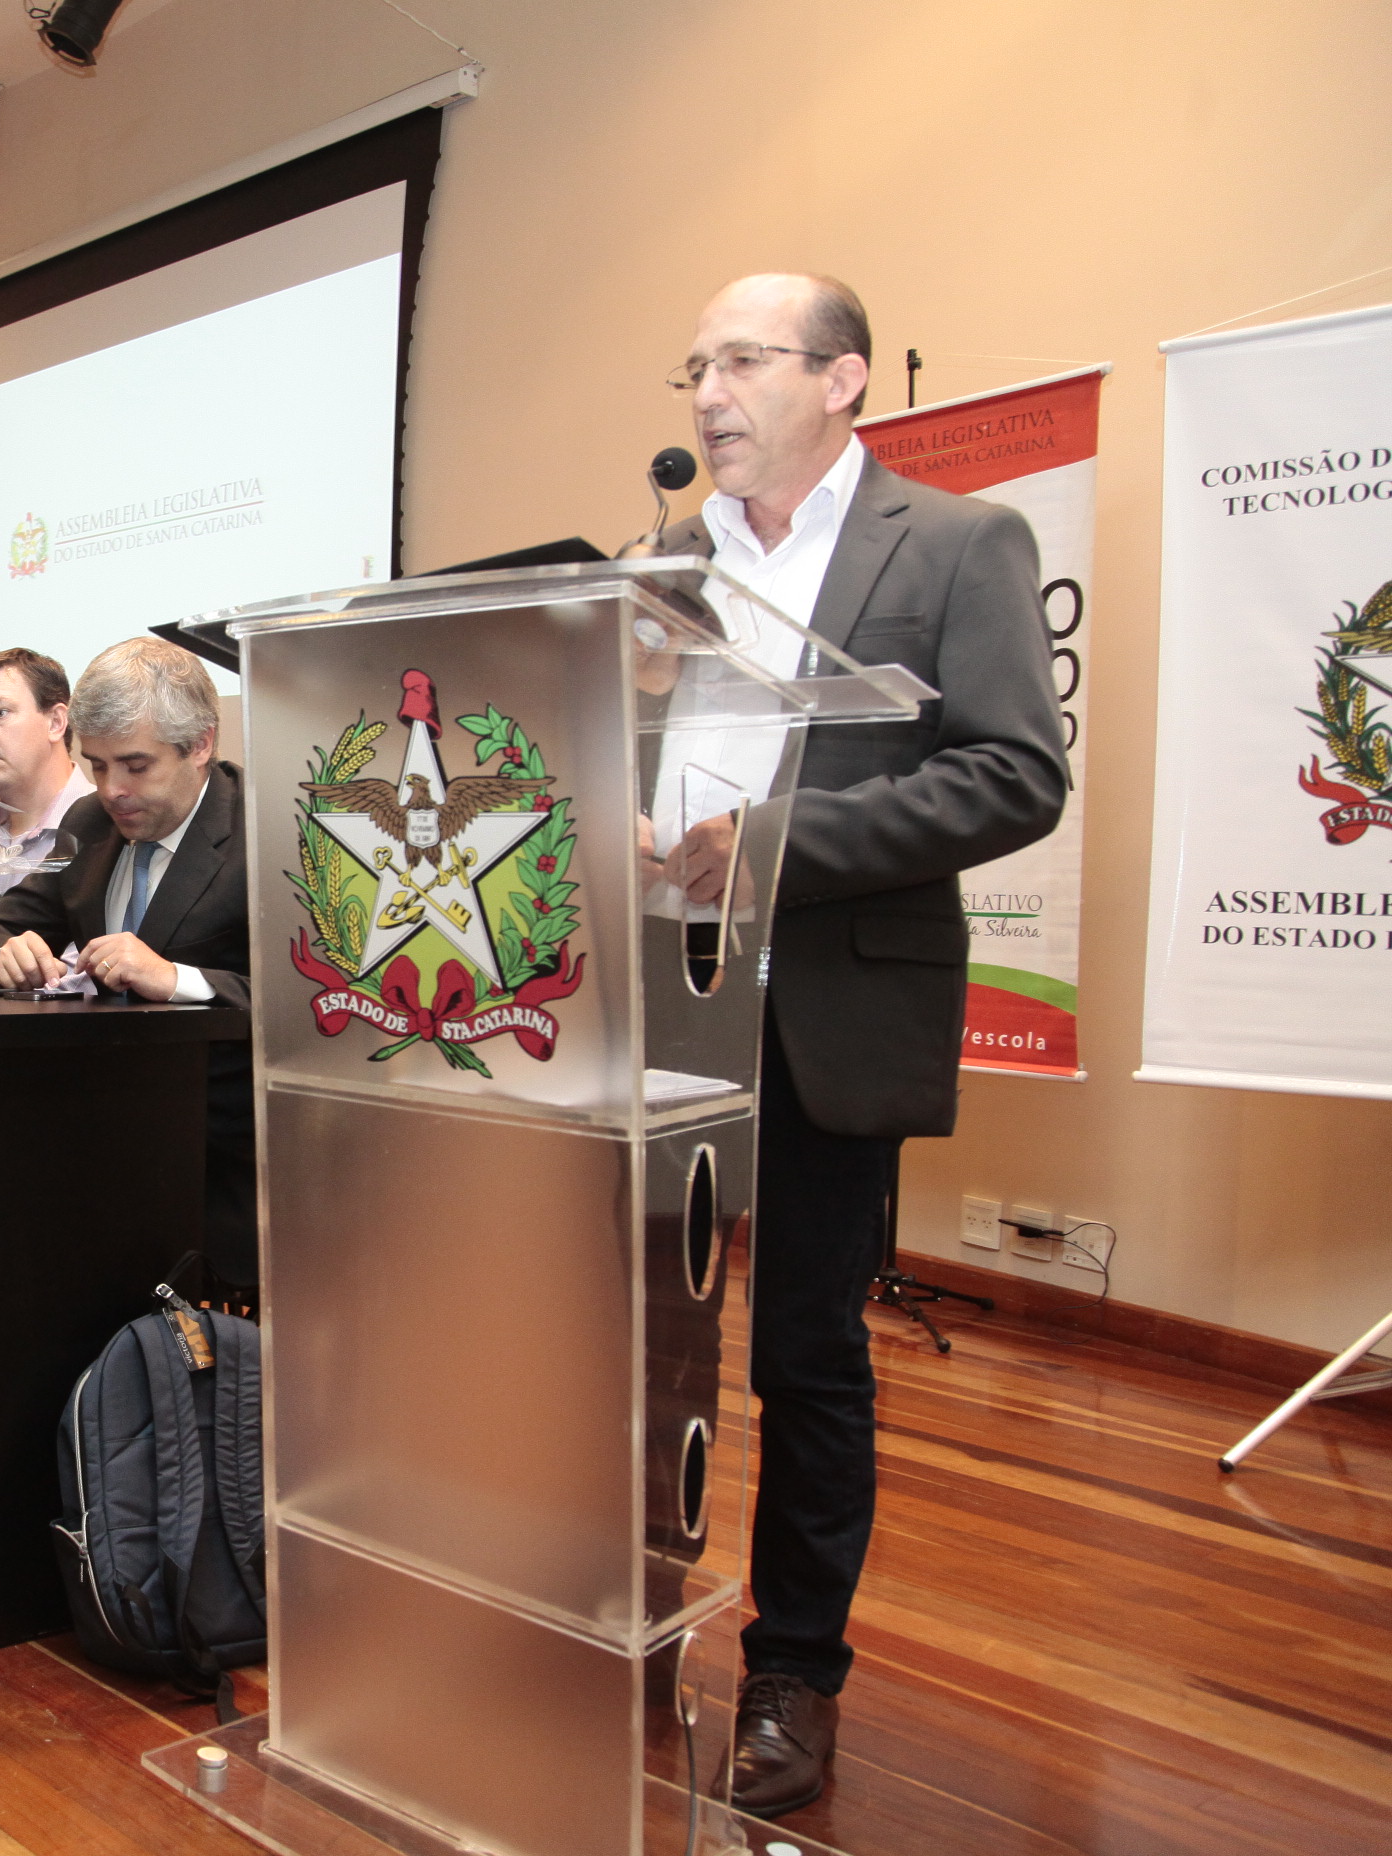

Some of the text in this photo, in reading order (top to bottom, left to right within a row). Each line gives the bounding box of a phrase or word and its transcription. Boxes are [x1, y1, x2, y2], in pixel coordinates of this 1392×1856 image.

[932, 408, 1055, 449] LEGISLATIVA
[902, 435, 1056, 477] DE SANTA CATARINA
[1201, 449, 1361, 488] COMISSÃO
[55, 477, 263, 538] ASSEMBLEIA LEGISLATIVA
[1222, 479, 1392, 517] TECNOLOG
[54, 510, 263, 564] DO ESTADO DE SANTA CATARINA
[1327, 806, 1392, 828] ESTAD
[962, 893, 1043, 912] SLATIVO
[1205, 890, 1392, 917] ASSEMBLE
[984, 917, 1043, 938] Silveira
[1202, 925, 1244, 945] DO
[1252, 926, 1376, 950] ESTADO
[317, 992, 409, 1034] ESTADO DE
[176, 1332, 193, 1364] victoria
